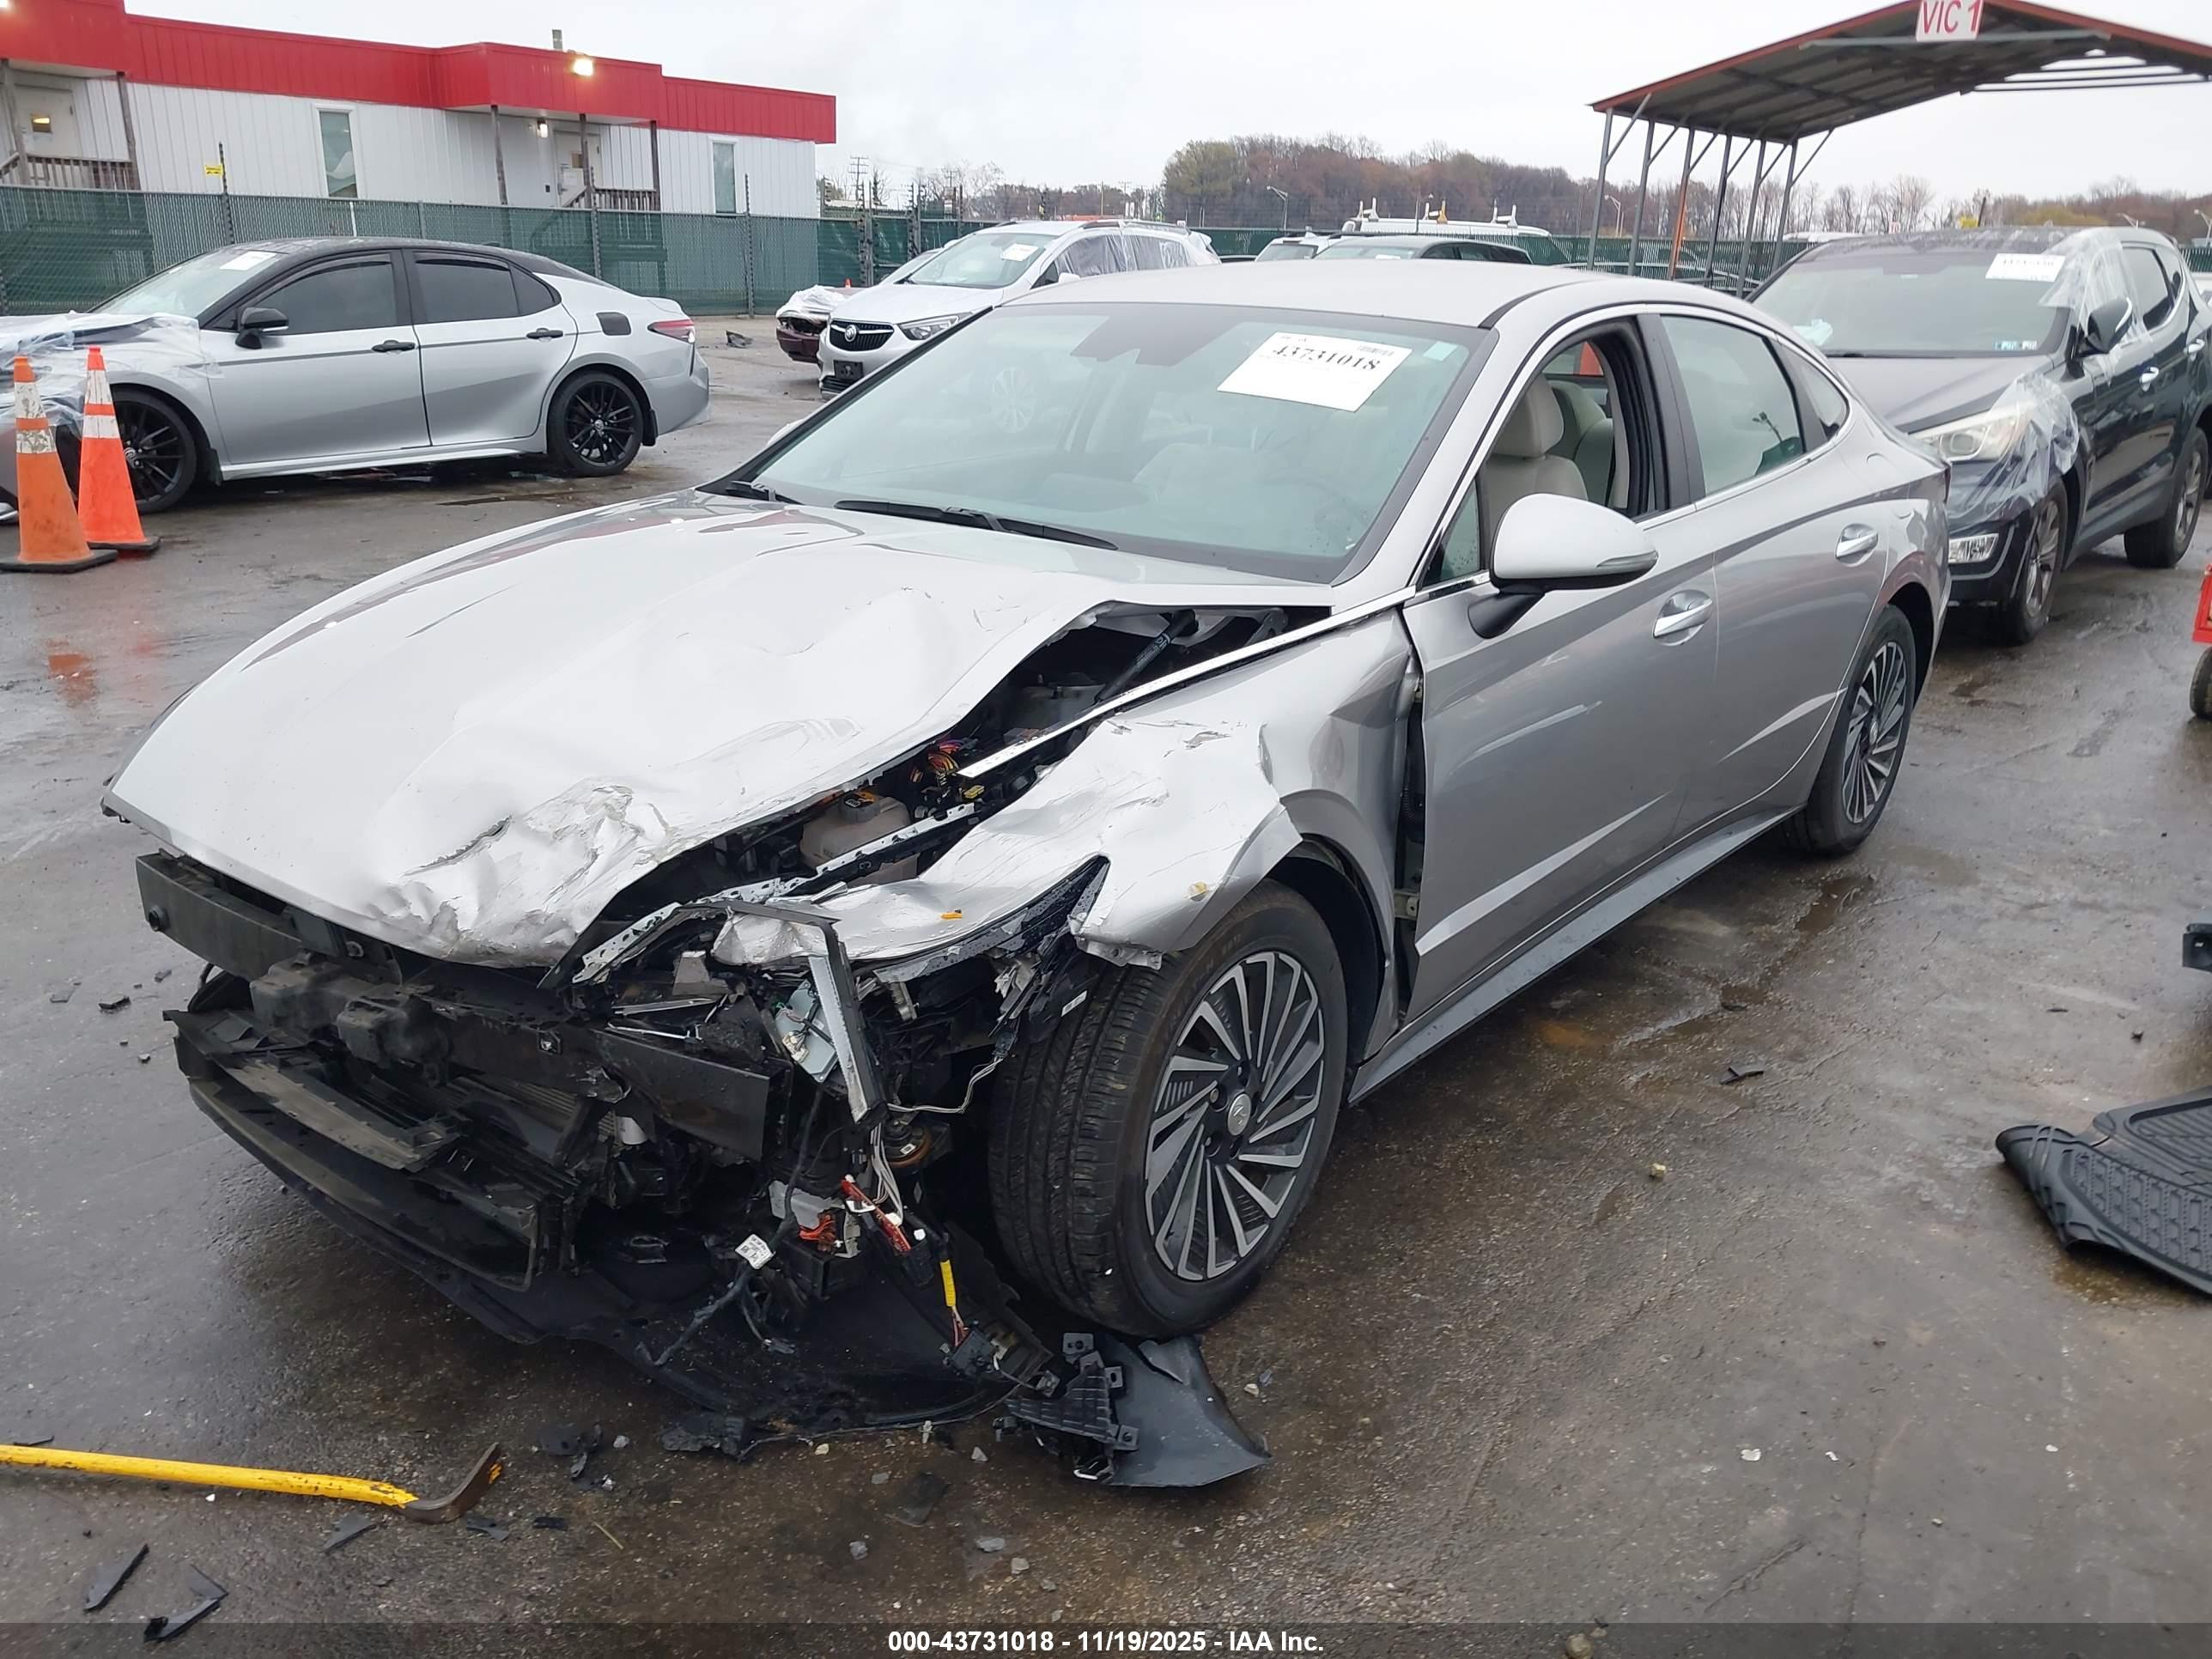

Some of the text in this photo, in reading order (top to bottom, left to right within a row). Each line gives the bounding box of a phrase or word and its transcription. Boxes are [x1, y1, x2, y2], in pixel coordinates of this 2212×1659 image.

[1923, 0, 1980, 33] VIC 1
[1273, 344, 1382, 371] 43731018
